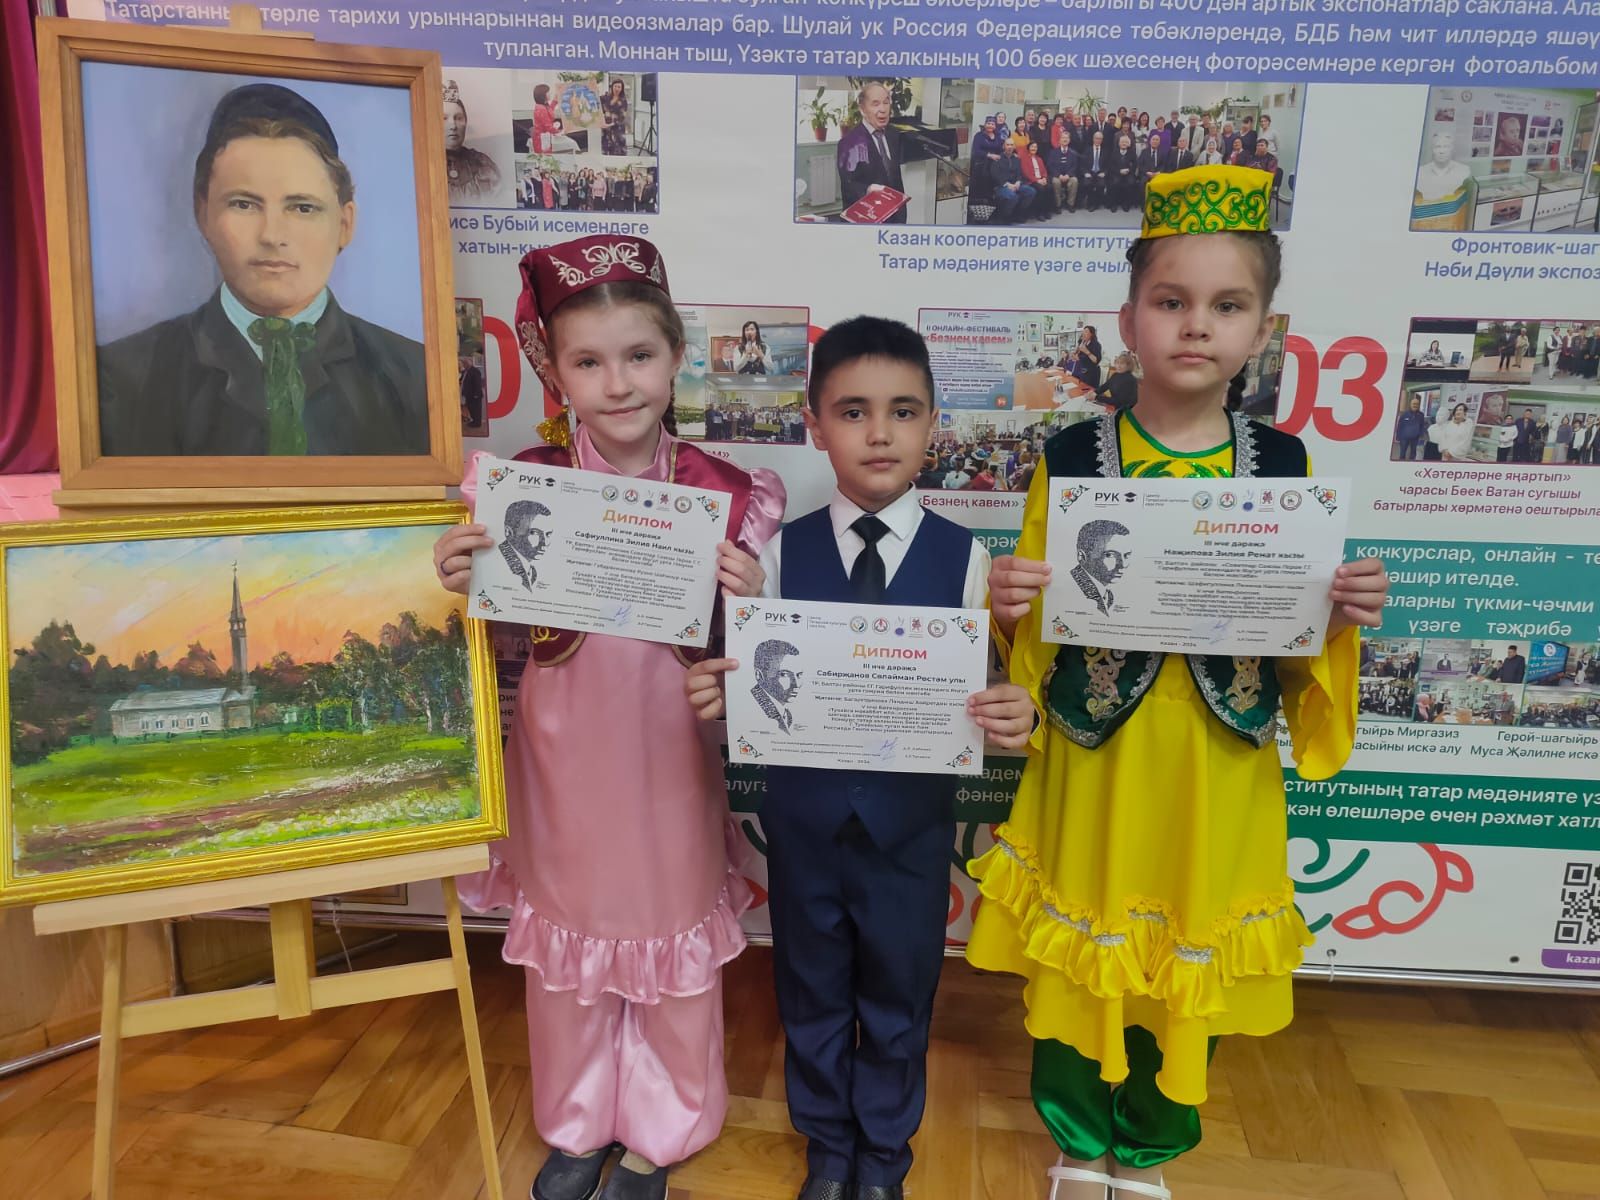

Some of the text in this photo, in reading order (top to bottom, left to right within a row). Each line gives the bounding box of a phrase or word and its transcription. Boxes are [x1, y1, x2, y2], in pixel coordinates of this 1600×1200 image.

[1252, 0, 1316, 15] артык
[1322, 0, 1460, 18] экспонатлар
[1465, 1, 1559, 17] саклана.
[259, 7, 320, 27] төрле
[328, 9, 400, 29] тарихи
[408, 11, 564, 31] урыннарыннан
[572, 15, 724, 37] видеоязмалар
[732, 14, 775, 37] бар.
[783, 16, 852, 37] Шулай
[861, 20, 884, 39] ук
[893, 18, 968, 36] Россия
[976, 18, 1122, 42] Федерациясе
[1131, 22, 1286, 45] төбәкләрендә,
[1295, 24, 1340, 46] БДБ
[1401, 27, 1438, 44] чит
[1445, 29, 1537, 48] илләрдә
[484, 41, 1599, 78] тупланган. Моннан тыш, Үзәктә татар халкының 100 бөек шәхесенең фоторәсемнәре кергән фотоальбом
[483, 214, 540, 235] Бубый
[543, 219, 650, 238] исемендәге
[877, 230, 931, 246] Казан
[934, 234, 1039, 252] кооператив
[878, 254, 929, 272] Татар
[932, 257, 1031, 275] мәдәнияте
[1035, 259, 1083, 276] үзәге
[1425, 261, 1473, 279] Нәби
[1475, 263, 1535, 282] Дәүли
[518, 474, 541, 487] РУК
[1414, 467, 1572, 484] «Хәтерләрне яңартып»
[1094, 492, 1121, 503] РУК
[1399, 485, 1582, 501] чарасы Бөек Ватан сугышы
[971, 498, 1019, 509] кавем»
[1373, 499, 1448, 515] батырлары
[1450, 503, 1523, 516] хөрмәтенә
[602, 508, 673, 531] Диплом
[1193, 520, 1281, 537] Диплом
[651, 543, 673, 552] Наил
[1356, 546, 1476, 565] конкурслар,
[1484, 546, 1556, 565] онлайн
[1445, 573, 1520, 590] ителде.
[1464, 597, 1595, 614] түкми-чәчми
[764, 612, 787, 624] РУК
[1408, 620, 1572, 639] үзәге тәҗрибә
[852, 643, 928, 662] Диплом
[1397, 727, 1460, 741] Миргазиз
[1497, 731, 1599, 747] Герой-шагыйрь
[1407, 744, 1437, 754] искә
[1439, 745, 1462, 756] алу
[1470, 745, 1504, 758] Муса
[1506, 746, 1567, 759] Җәлилне
[1568, 751, 1599, 760] искә
[1408, 785, 1463, 802] татар
[1467, 788, 1578, 805] мәдәнияте
[1326, 806, 1426, 824] өлешләре
[1429, 811, 1477, 824] өчен
[1481, 811, 1555, 828] рәхмәт
